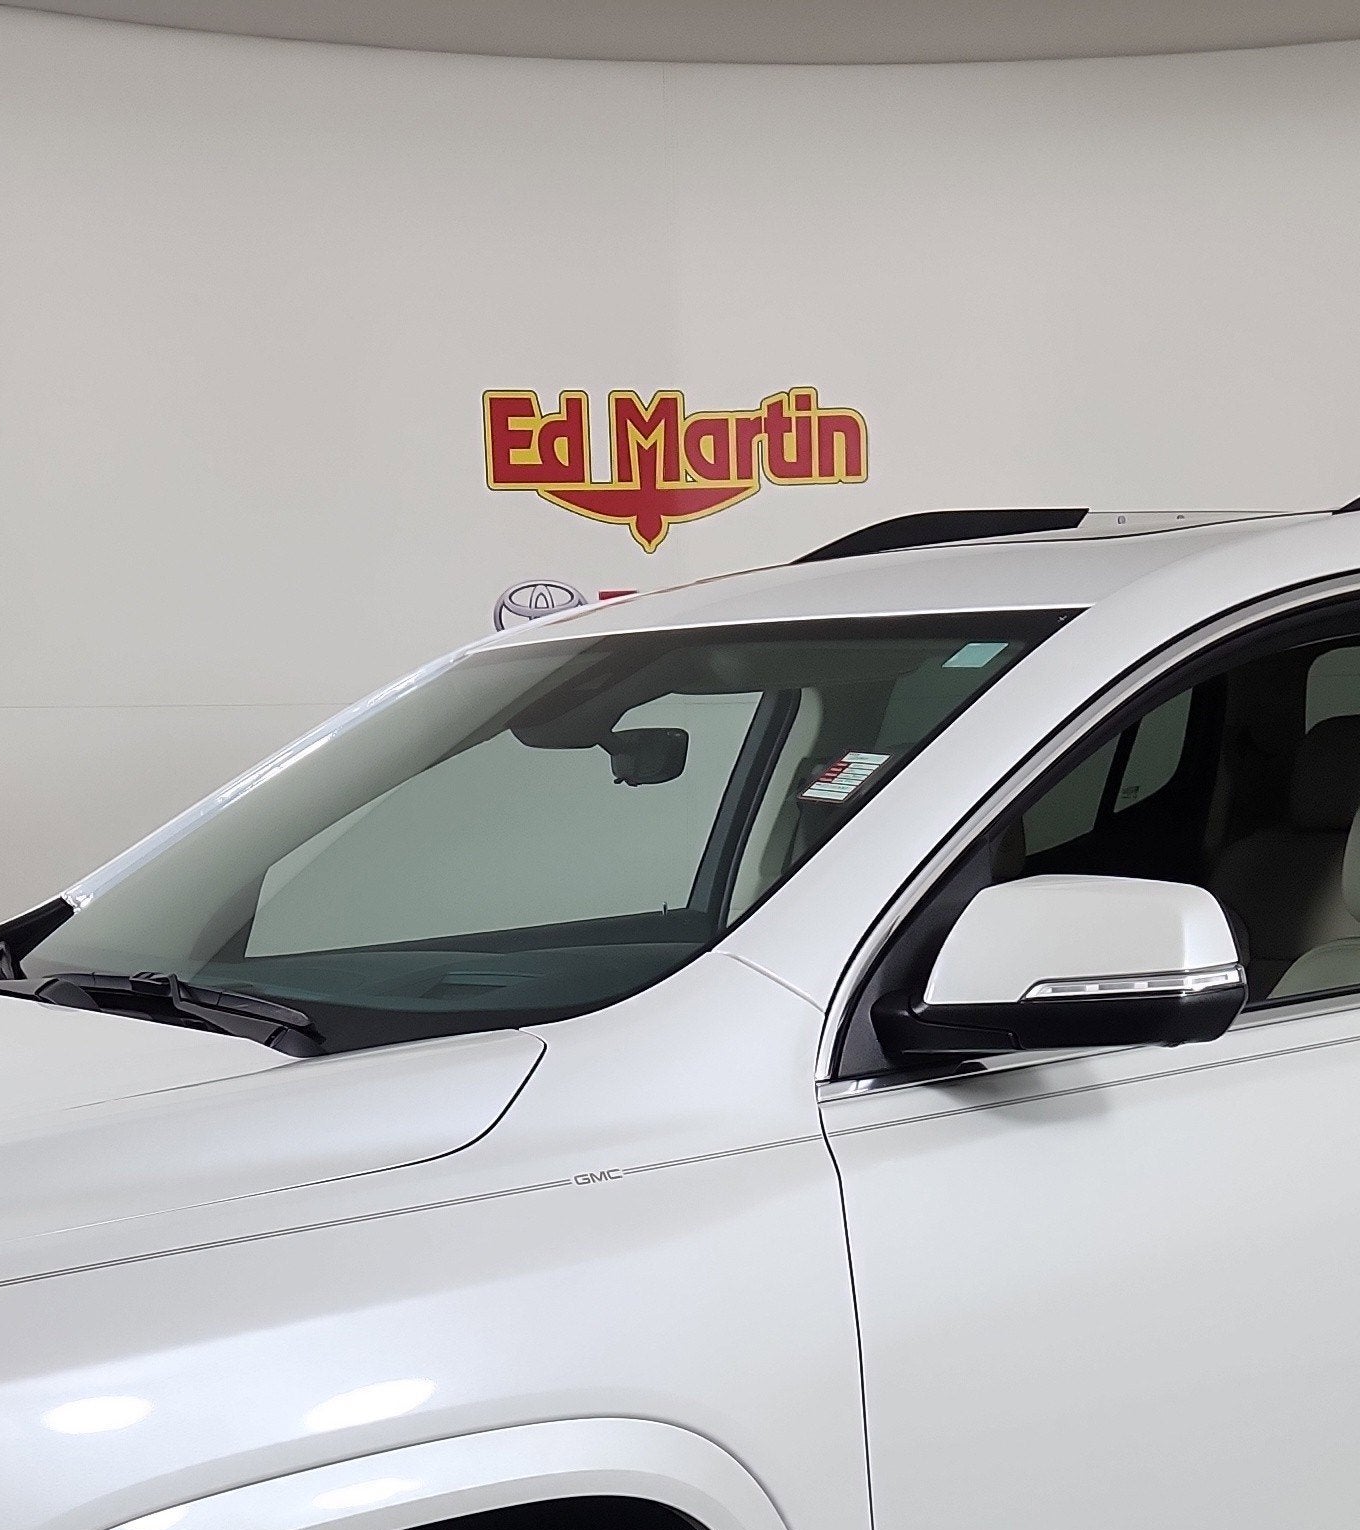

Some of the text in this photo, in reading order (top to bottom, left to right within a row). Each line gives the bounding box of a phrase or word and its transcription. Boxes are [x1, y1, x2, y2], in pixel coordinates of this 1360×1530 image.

[486, 389, 865, 486] Ed Martin
[573, 1168, 623, 1186] GMC
